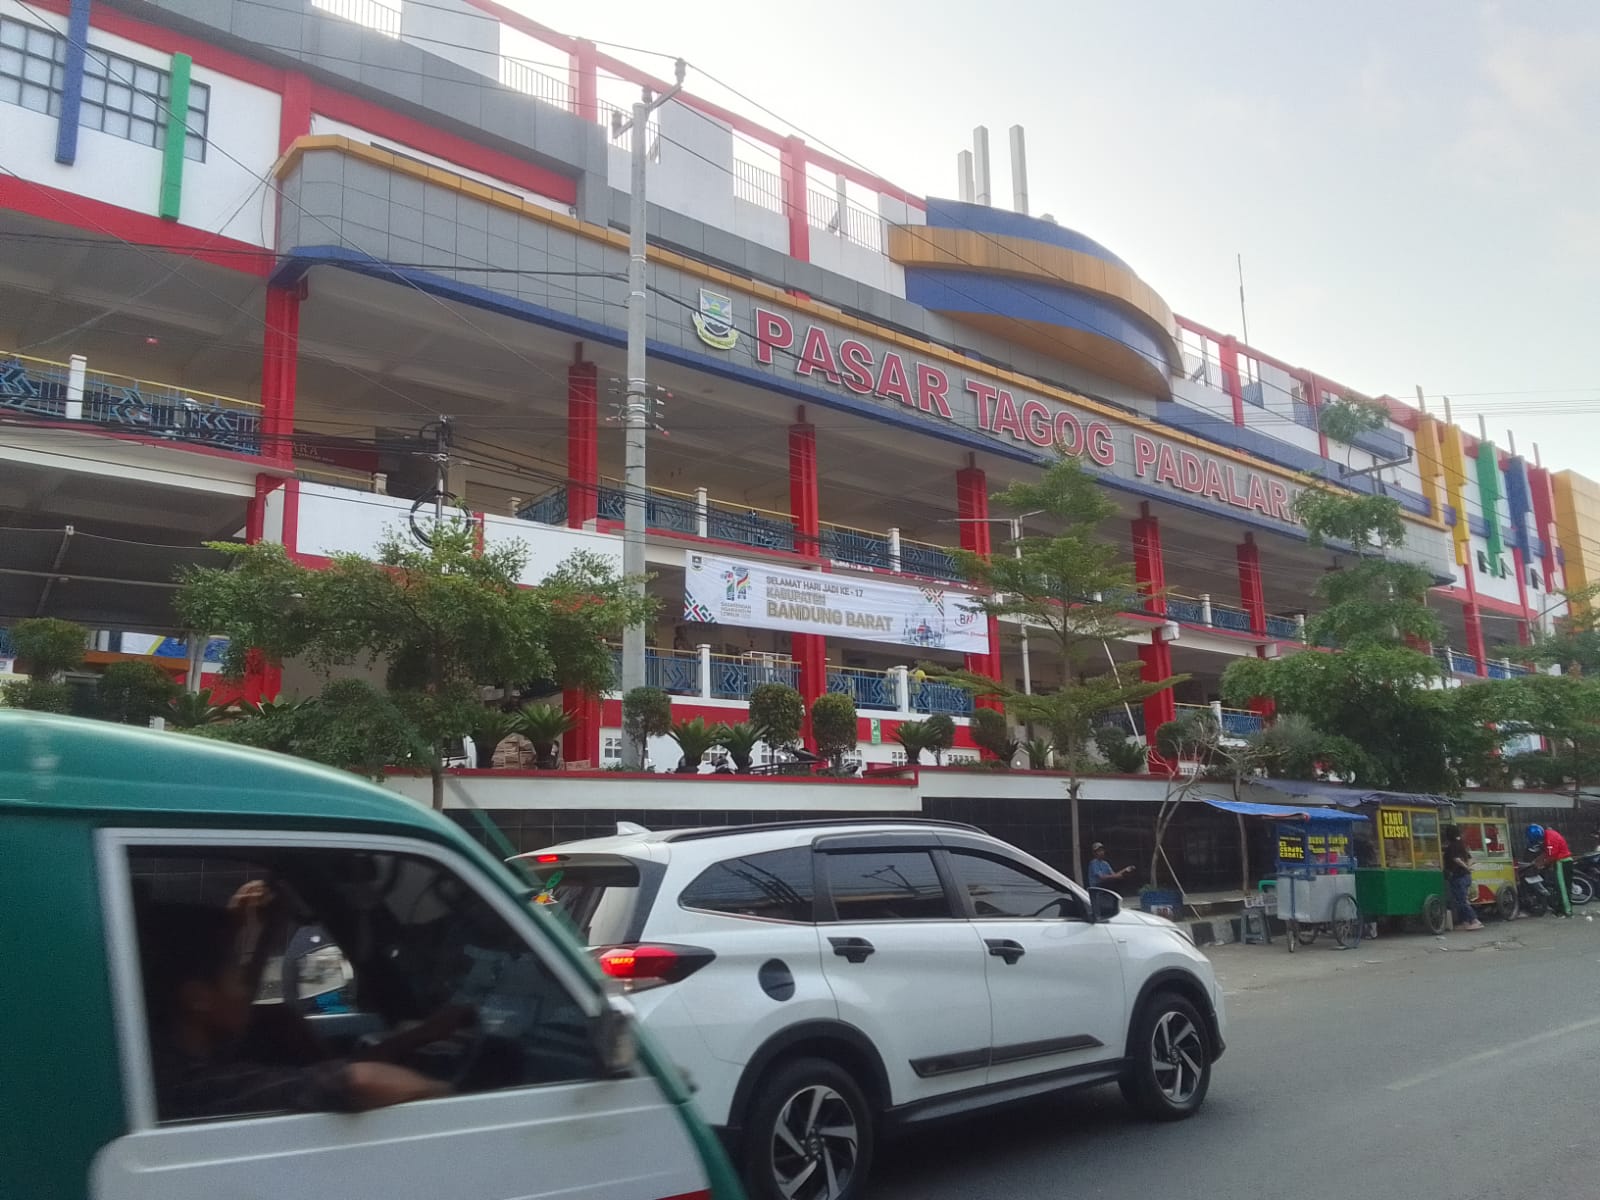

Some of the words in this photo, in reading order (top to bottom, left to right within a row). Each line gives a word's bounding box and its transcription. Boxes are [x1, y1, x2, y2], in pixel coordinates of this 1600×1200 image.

[756, 307, 952, 419] PASAR
[966, 378, 1116, 466] TAGOG
[766, 575, 801, 589] SELAMAT
[803, 580, 821, 591] HARI
[822, 583, 839, 594] JADI
[840, 585, 850, 595] KE
[855, 588, 864, 597] 17
[766, 599, 843, 625] BANDUNG
[845, 610, 894, 632] BARAT
[1383, 812, 1403, 825] TAHU
[1383, 825, 1409, 838] KRISPI
